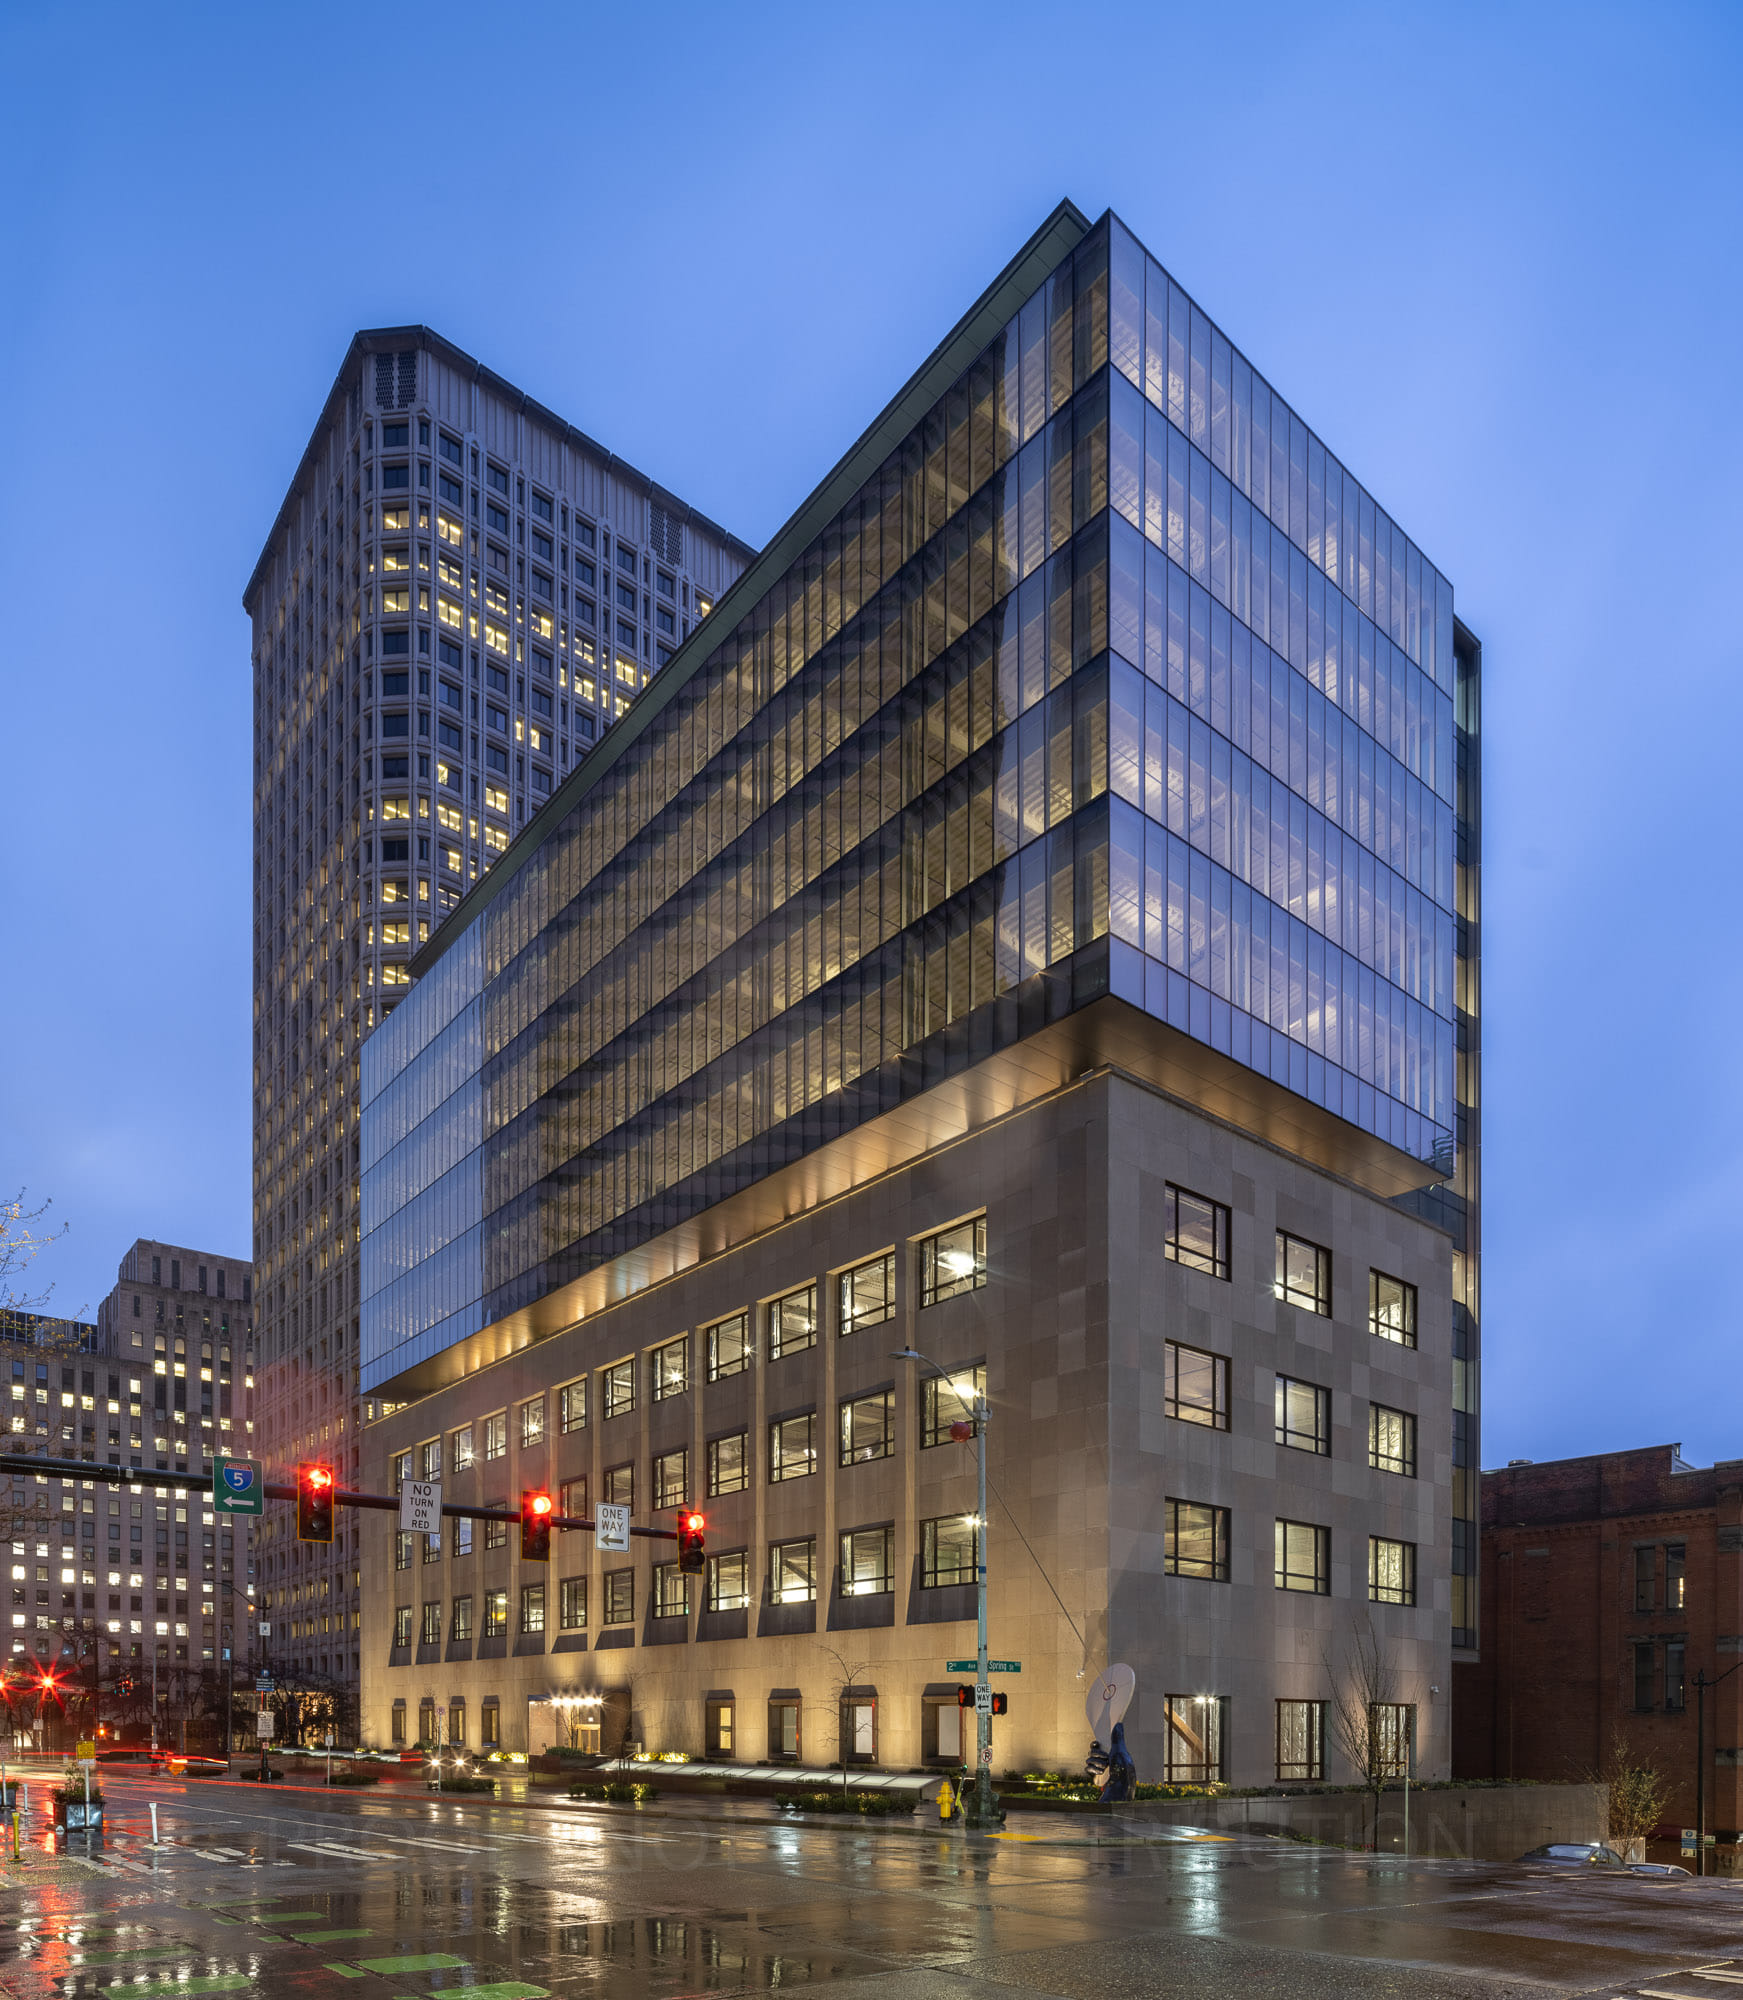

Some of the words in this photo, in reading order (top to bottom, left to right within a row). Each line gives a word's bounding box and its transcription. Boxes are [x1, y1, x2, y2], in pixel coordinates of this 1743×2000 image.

[233, 1472, 244, 1487] 5
[413, 1484, 432, 1496] NO
[410, 1496, 434, 1508] TURN
[414, 1508, 427, 1518] ON
[601, 1507, 623, 1520] ONE
[411, 1519, 430, 1529] RED
[601, 1519, 624, 1532] WAY
[989, 1661, 1007, 1671] Spring
[977, 1685, 990, 1693] ONE
[977, 1694, 990, 1702] WAY
